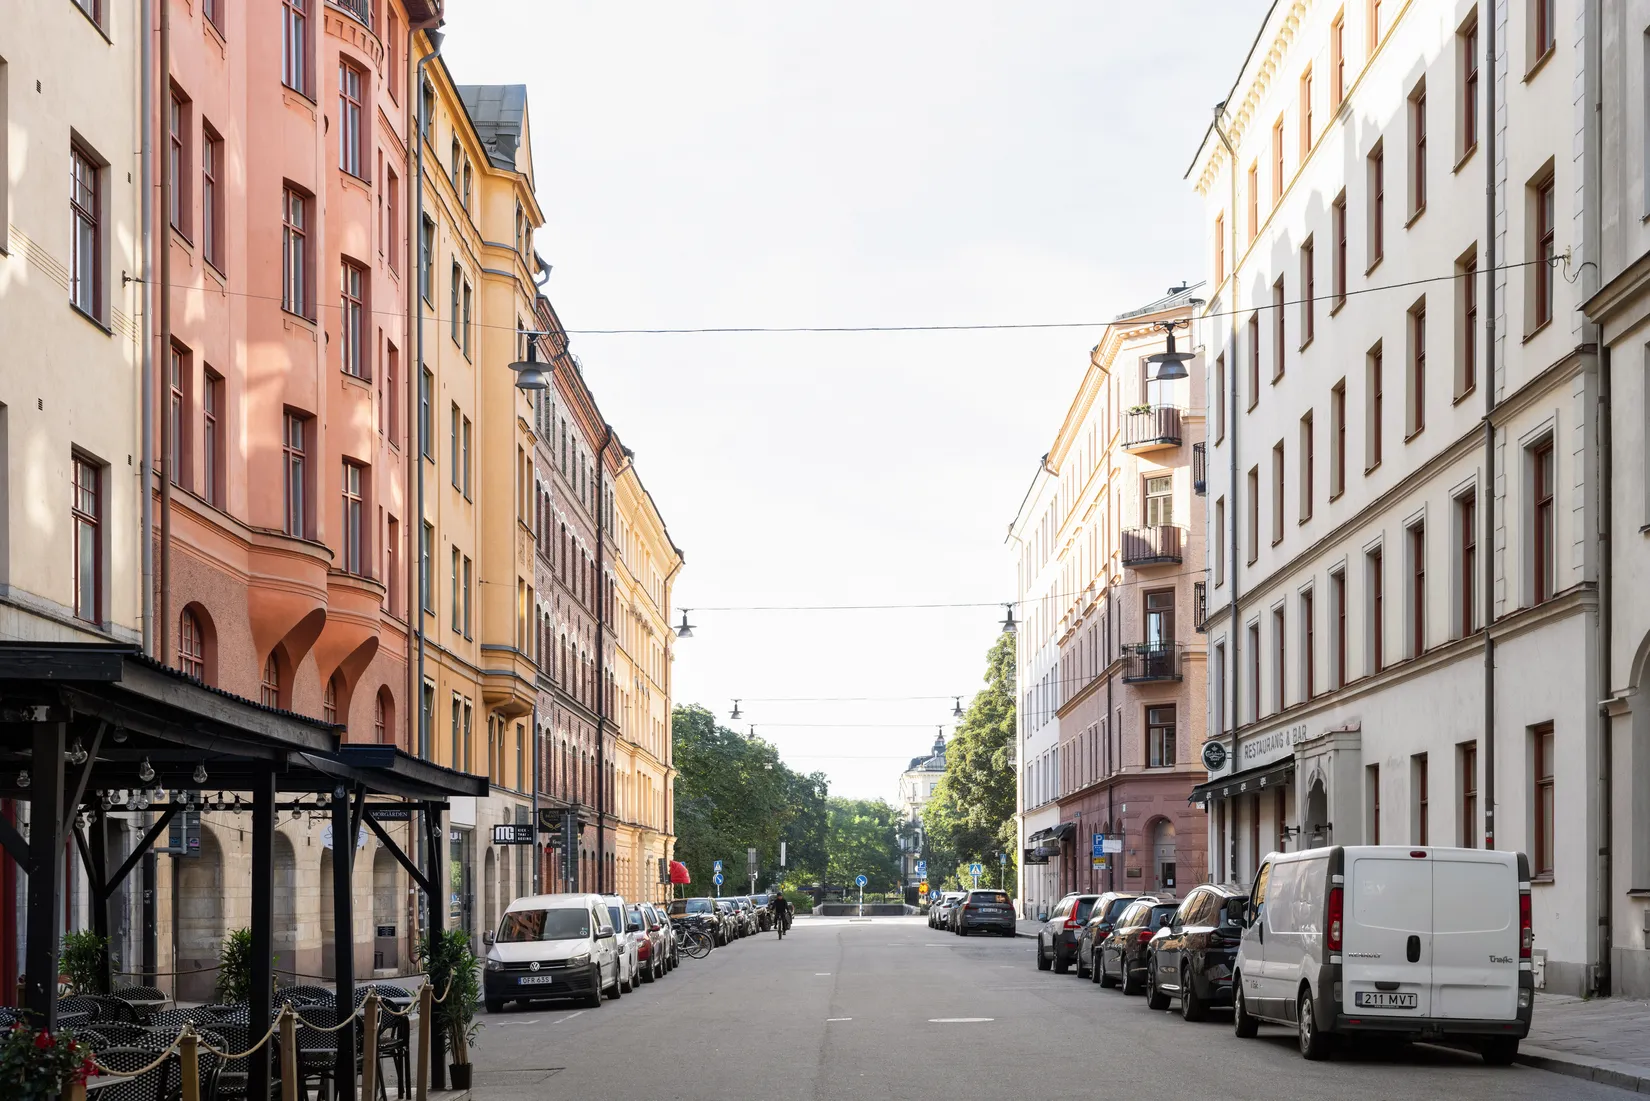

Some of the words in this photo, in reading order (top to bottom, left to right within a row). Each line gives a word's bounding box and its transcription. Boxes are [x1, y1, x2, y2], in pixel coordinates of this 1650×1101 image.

[1244, 732, 1284, 760] RESTAURANG
[1285, 731, 1291, 747] &
[1292, 724, 1307, 744] BAR
[495, 826, 515, 840] MG
[1095, 835, 1103, 845] P
[1364, 994, 1383, 1005] 211
[1388, 994, 1414, 1005] MVT
